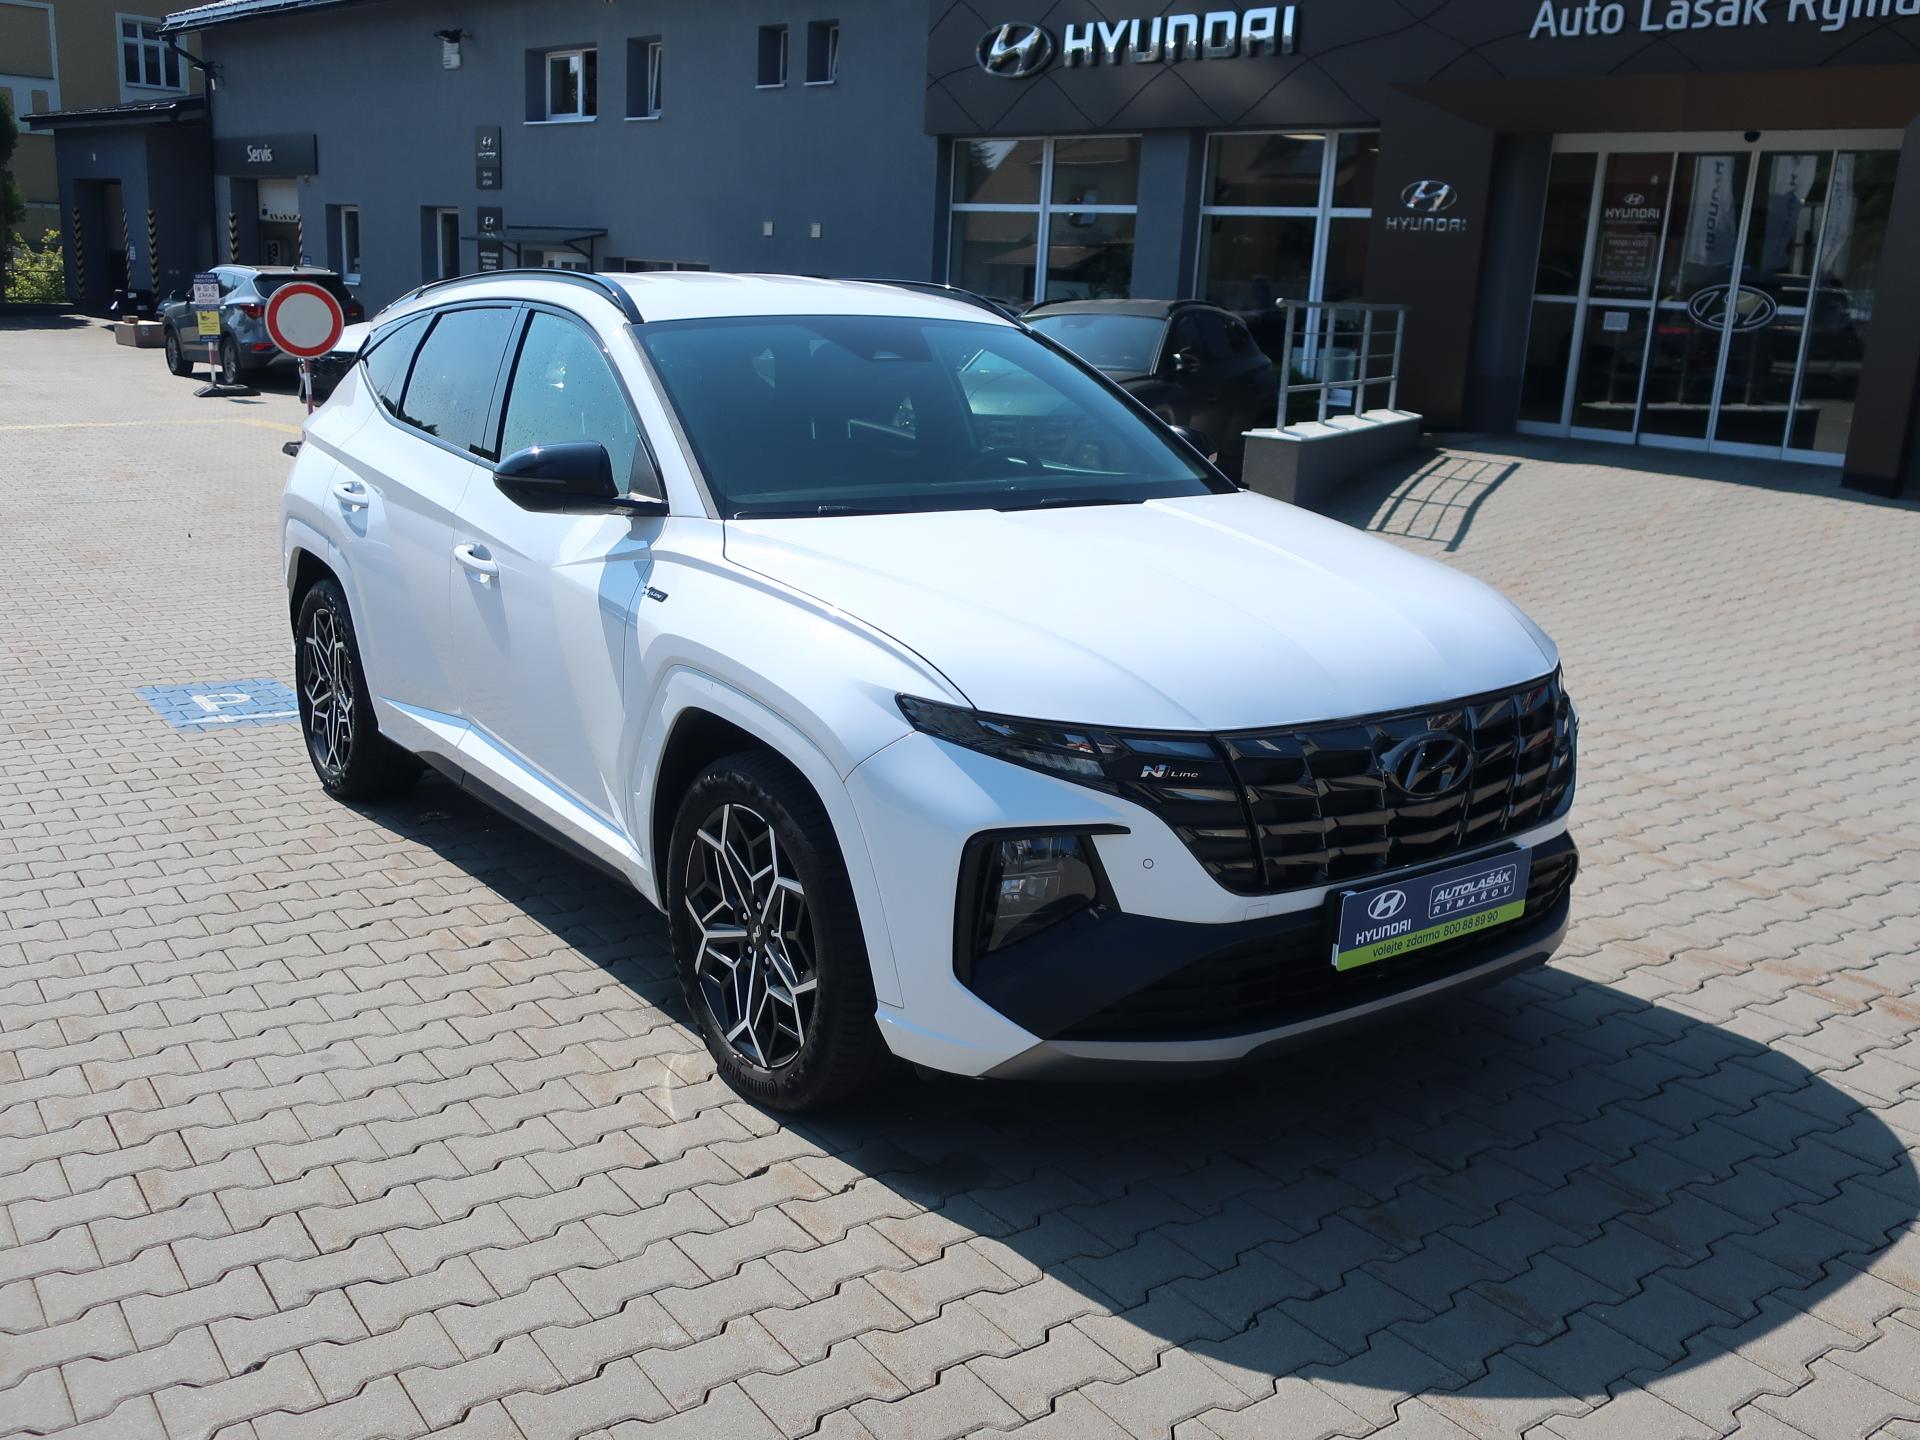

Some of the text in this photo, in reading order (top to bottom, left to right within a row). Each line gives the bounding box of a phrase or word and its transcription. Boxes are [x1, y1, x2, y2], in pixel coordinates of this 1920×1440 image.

[1529, 0, 1626, 40] Auto
[1063, 5, 1297, 67] HYUNDAI
[247, 144, 273, 162] Servis
[1385, 216, 1467, 232] HYUNDAI
[1605, 207, 1660, 219] HYUNDAI
[191, 693, 252, 713] P
[1434, 870, 1512, 903] AUTOLAŠÁK
[1355, 918, 1412, 945] HYUNDAI
[1372, 910, 1499, 957] volejte zdarma 800 88 89 90
